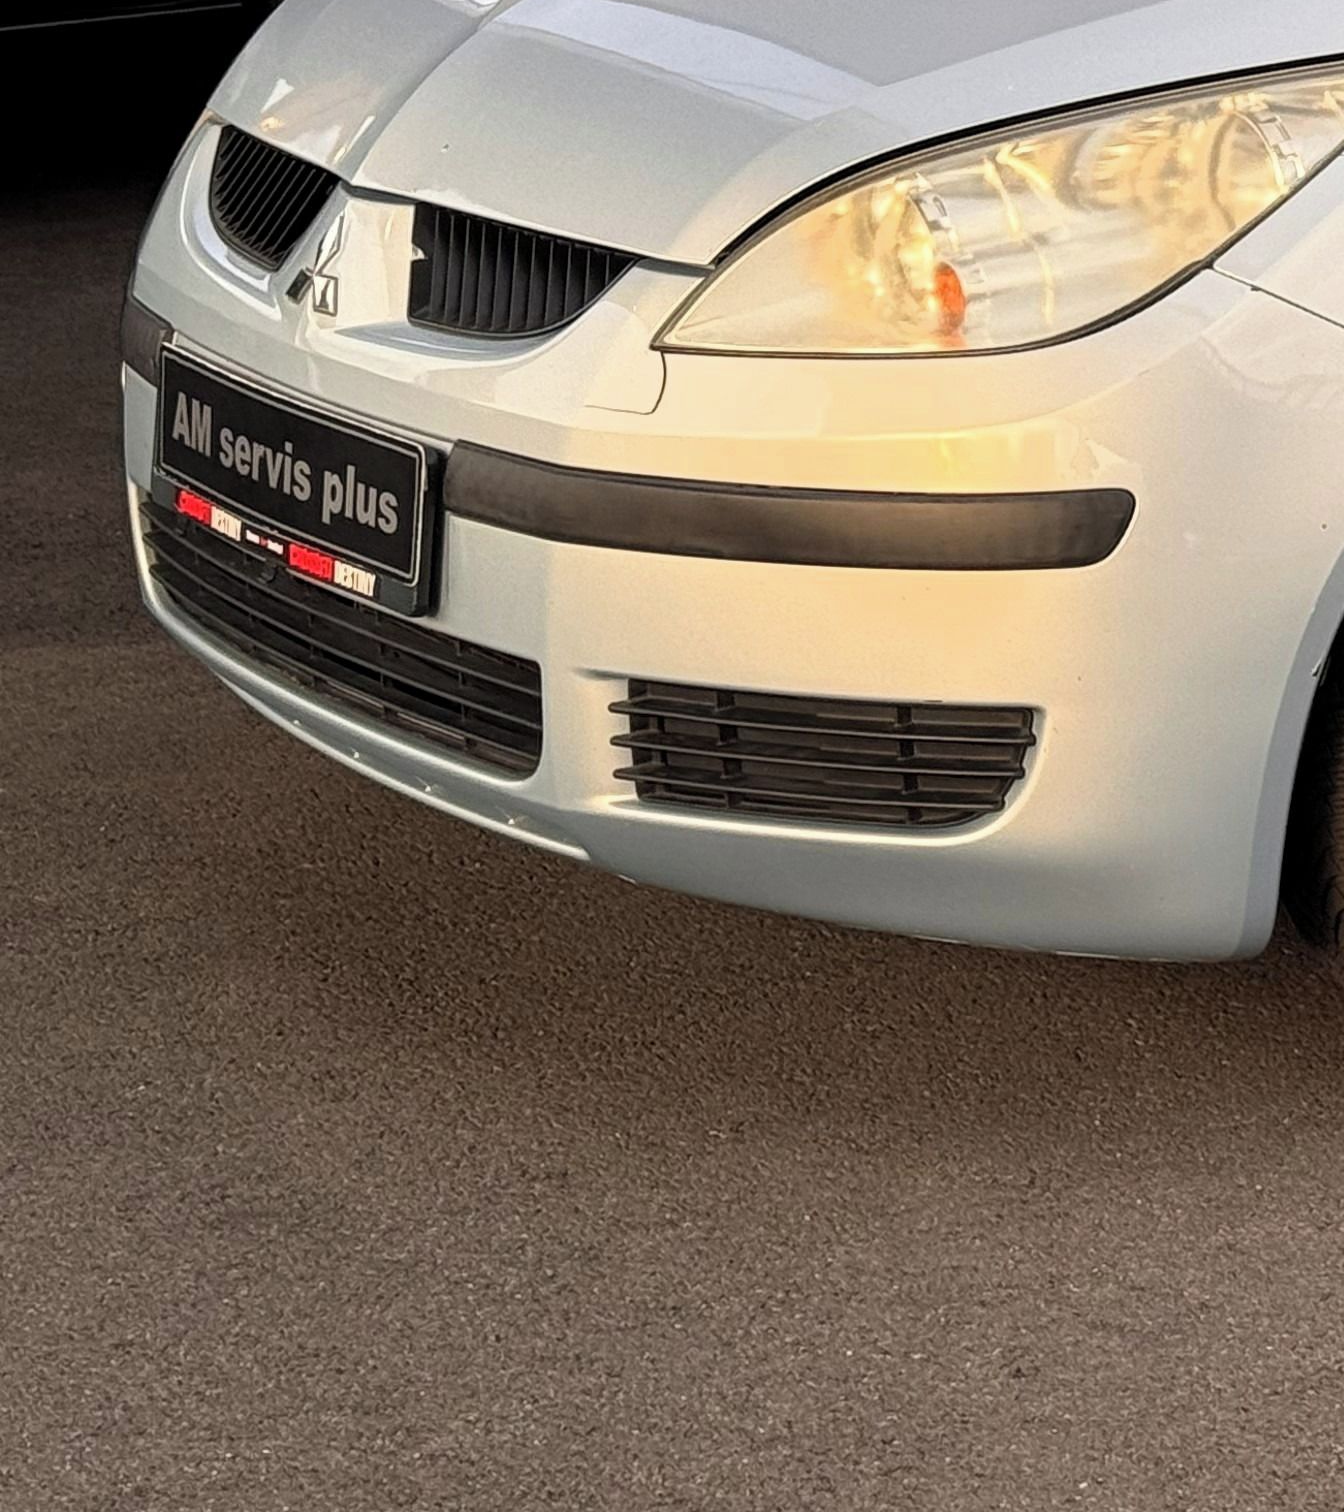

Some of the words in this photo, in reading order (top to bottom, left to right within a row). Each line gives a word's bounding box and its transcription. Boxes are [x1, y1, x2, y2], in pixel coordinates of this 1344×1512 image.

[172, 391, 212, 458] AM
[219, 426, 312, 501] servis
[322, 465, 399, 534] plus
